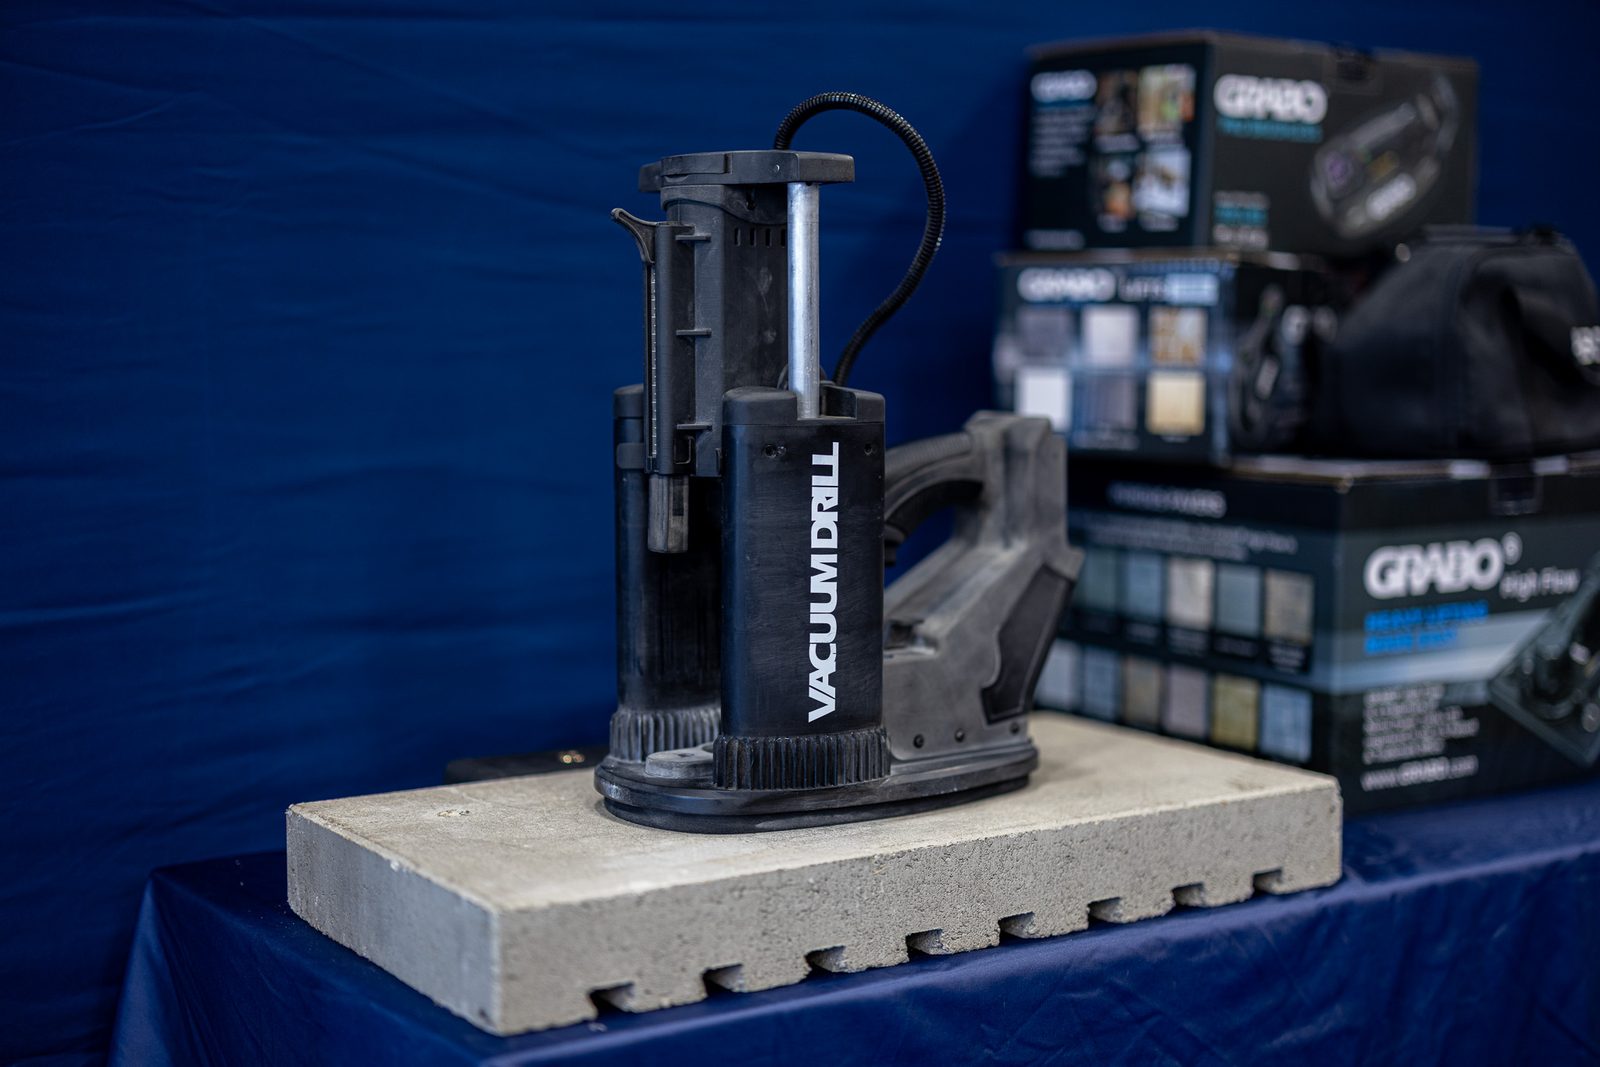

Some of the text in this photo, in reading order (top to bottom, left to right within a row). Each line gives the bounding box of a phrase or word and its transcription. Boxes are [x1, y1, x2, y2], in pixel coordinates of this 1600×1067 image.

[1214, 74, 1327, 124] GRABO
[808, 441, 840, 723] VACUUM DRILL
[1364, 537, 1503, 600] GRABO
